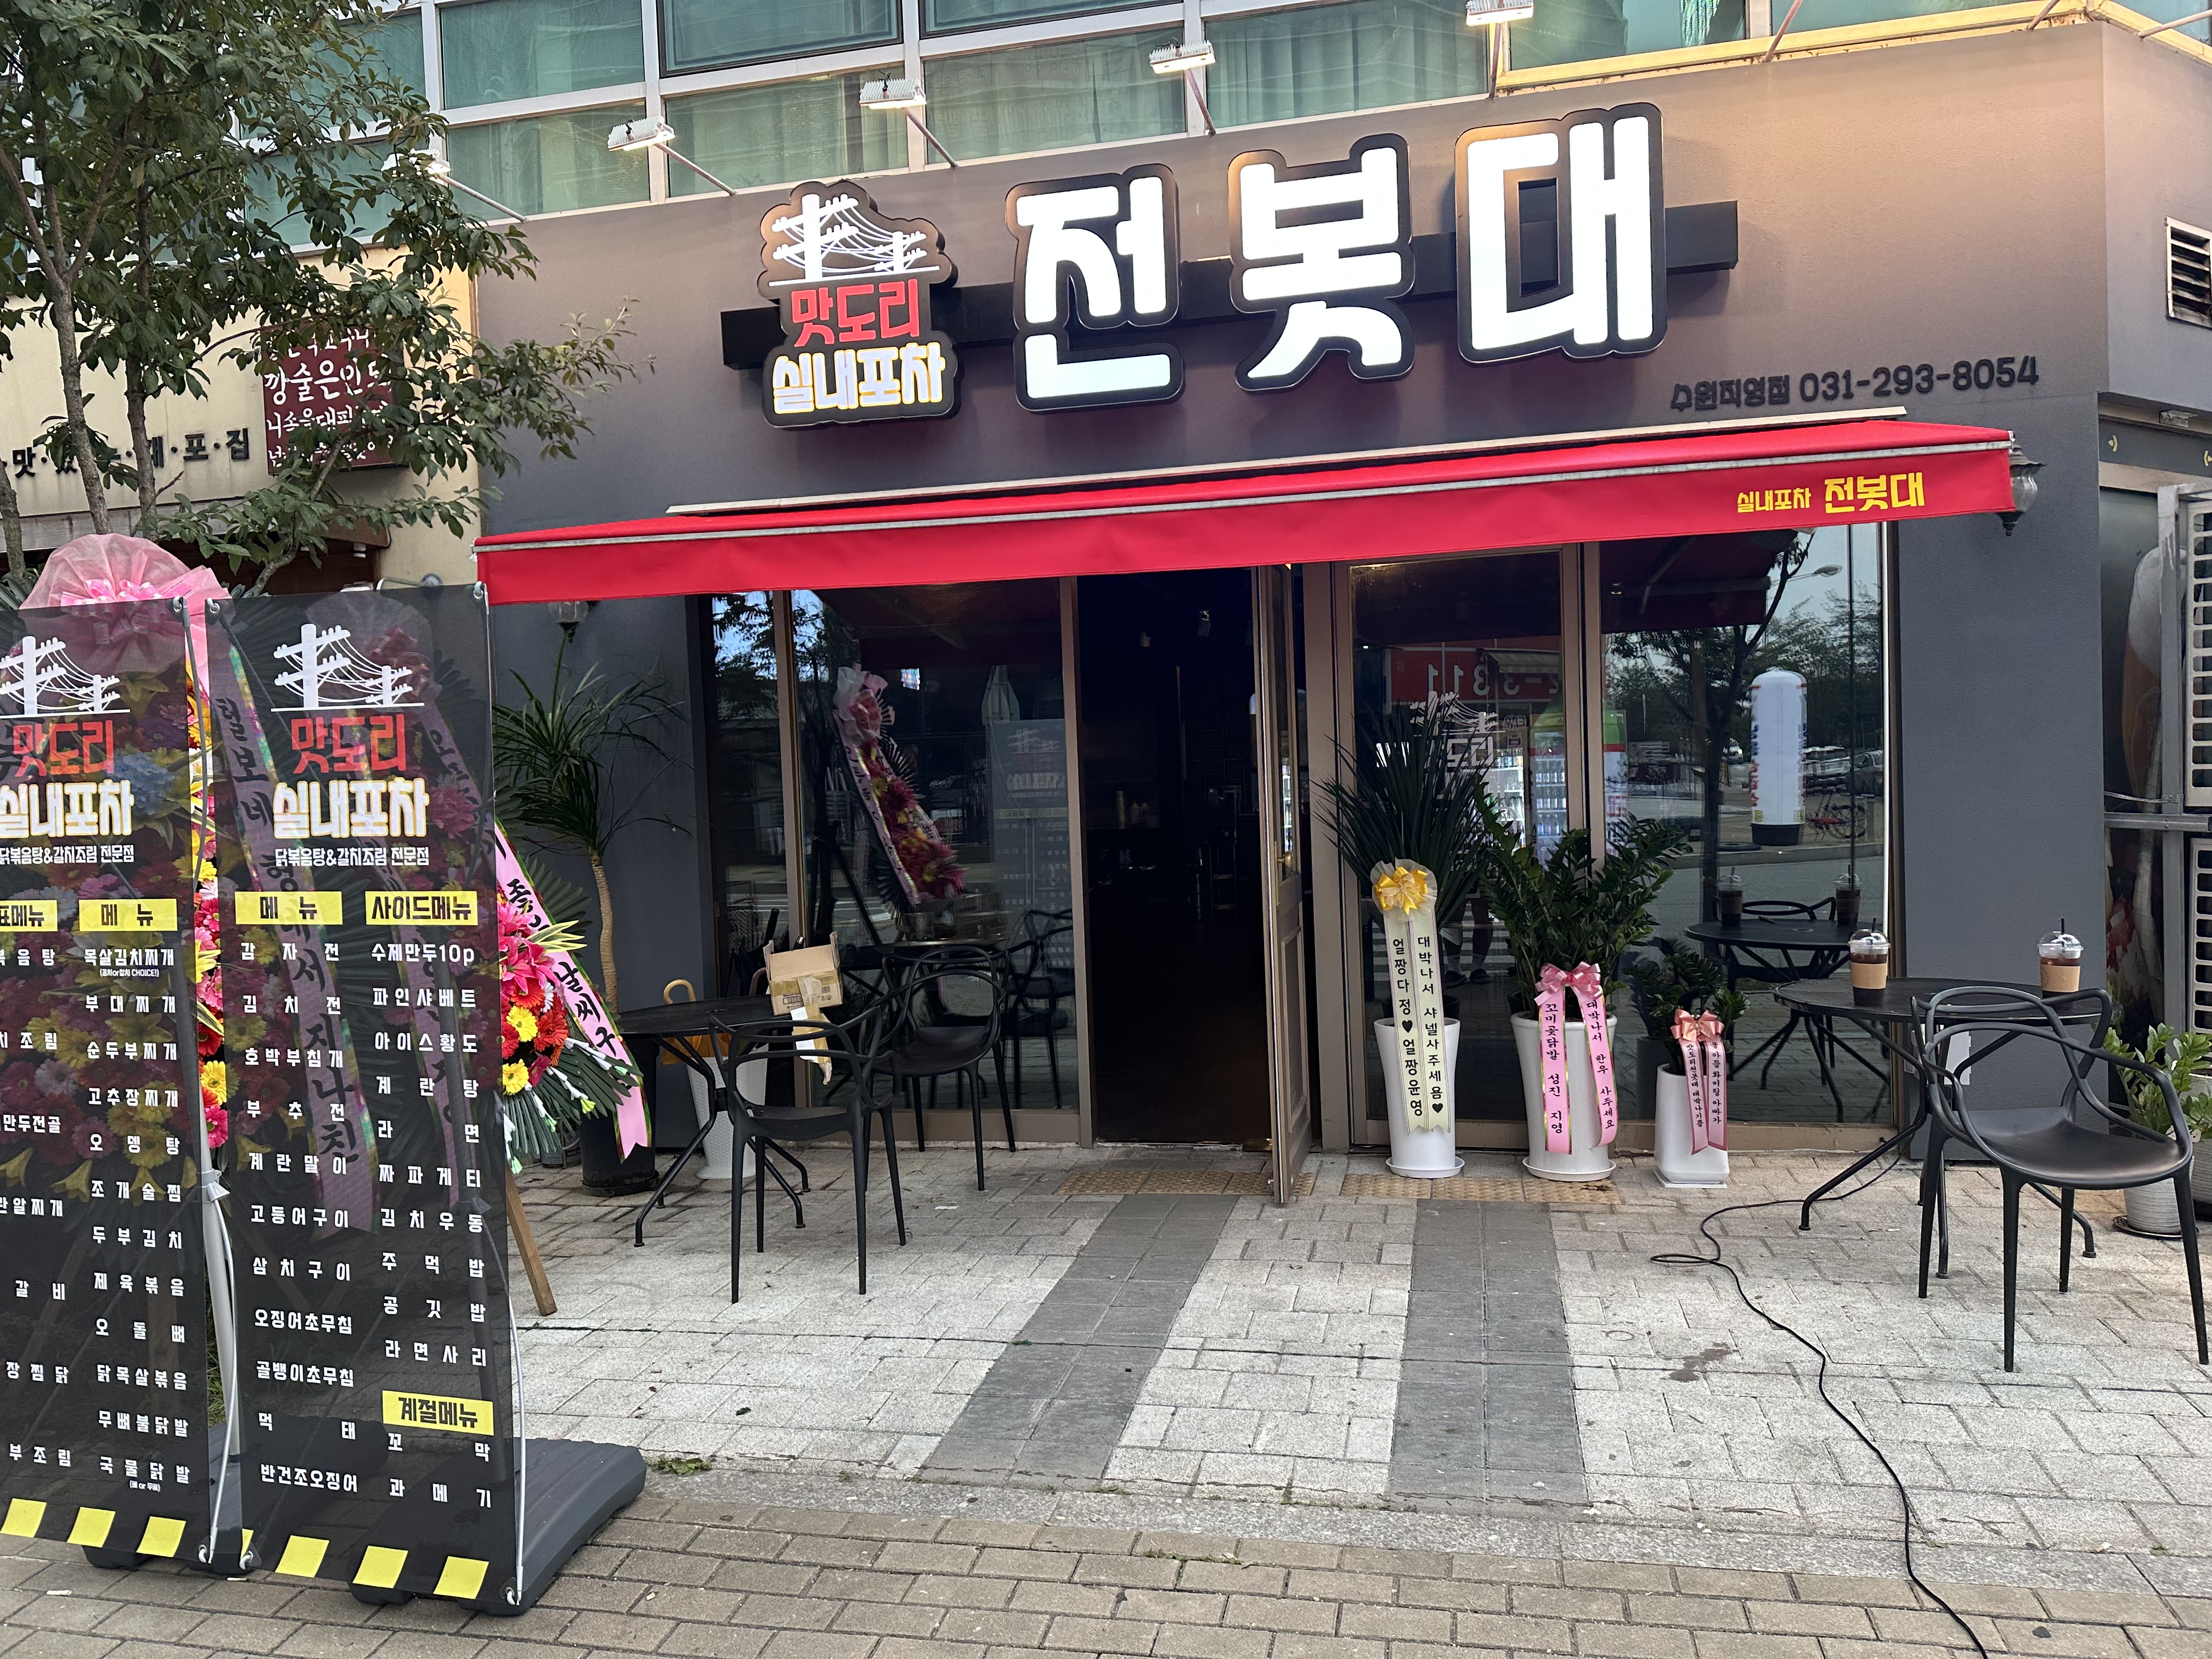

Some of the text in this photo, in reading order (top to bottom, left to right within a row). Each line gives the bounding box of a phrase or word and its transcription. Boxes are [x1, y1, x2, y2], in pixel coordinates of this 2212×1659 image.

[1016, 116, 1653, 399] 전봇대
[791, 279, 920, 348] 맛도리
[772, 342, 946, 414] 실내포차
[1671, 356, 2039, 411] 수원직영점 031-293-8054
[1737, 472, 1926, 514] 실내포차 전봇대
[13, 719, 115, 777] 맛도리
[291, 713, 407, 775] 맛도리
[0, 779, 134, 839] 실내포차
[273, 777, 430, 839] 실내포차
[100, 844, 135, 864] 전문점
[275, 847, 430, 867] 닭볶음탕&갈치조림 전문점
[371, 895, 472, 920] 사이드메뉴
[84, 948, 174, 966] 목살김치찌개
[371, 943, 475, 967] 수제만두10p
[1418, 935, 1434, 995] 대박나서
[373, 988, 476, 1008] 파인샤베트
[87, 1041, 177, 1060] 순두부찌개
[375, 1032, 477, 1053] 아이스황도
[245, 1047, 343, 1068] 호박부침개
[1585, 999, 1616, 1130] 대박나서 한우 사주세요
[88, 1087, 178, 1108] 고추장찌개
[1547, 1073, 1561, 1097] 성진
[0, 1114, 61, 1133] 만두전골
[1550, 1110, 1563, 1134] 지영
[251, 1205, 348, 1228] 고등어구이
[255, 1309, 352, 1335] 오징어초무침
[97, 1364, 187, 1390] 닭목살볶음
[256, 1361, 354, 1387] 골뱅이초무침
[98, 1410, 188, 1437] 무뼈불닭발
[398, 1397, 478, 1429] 계절메뉴
[261, 1464, 357, 1492] 반건조오징어
